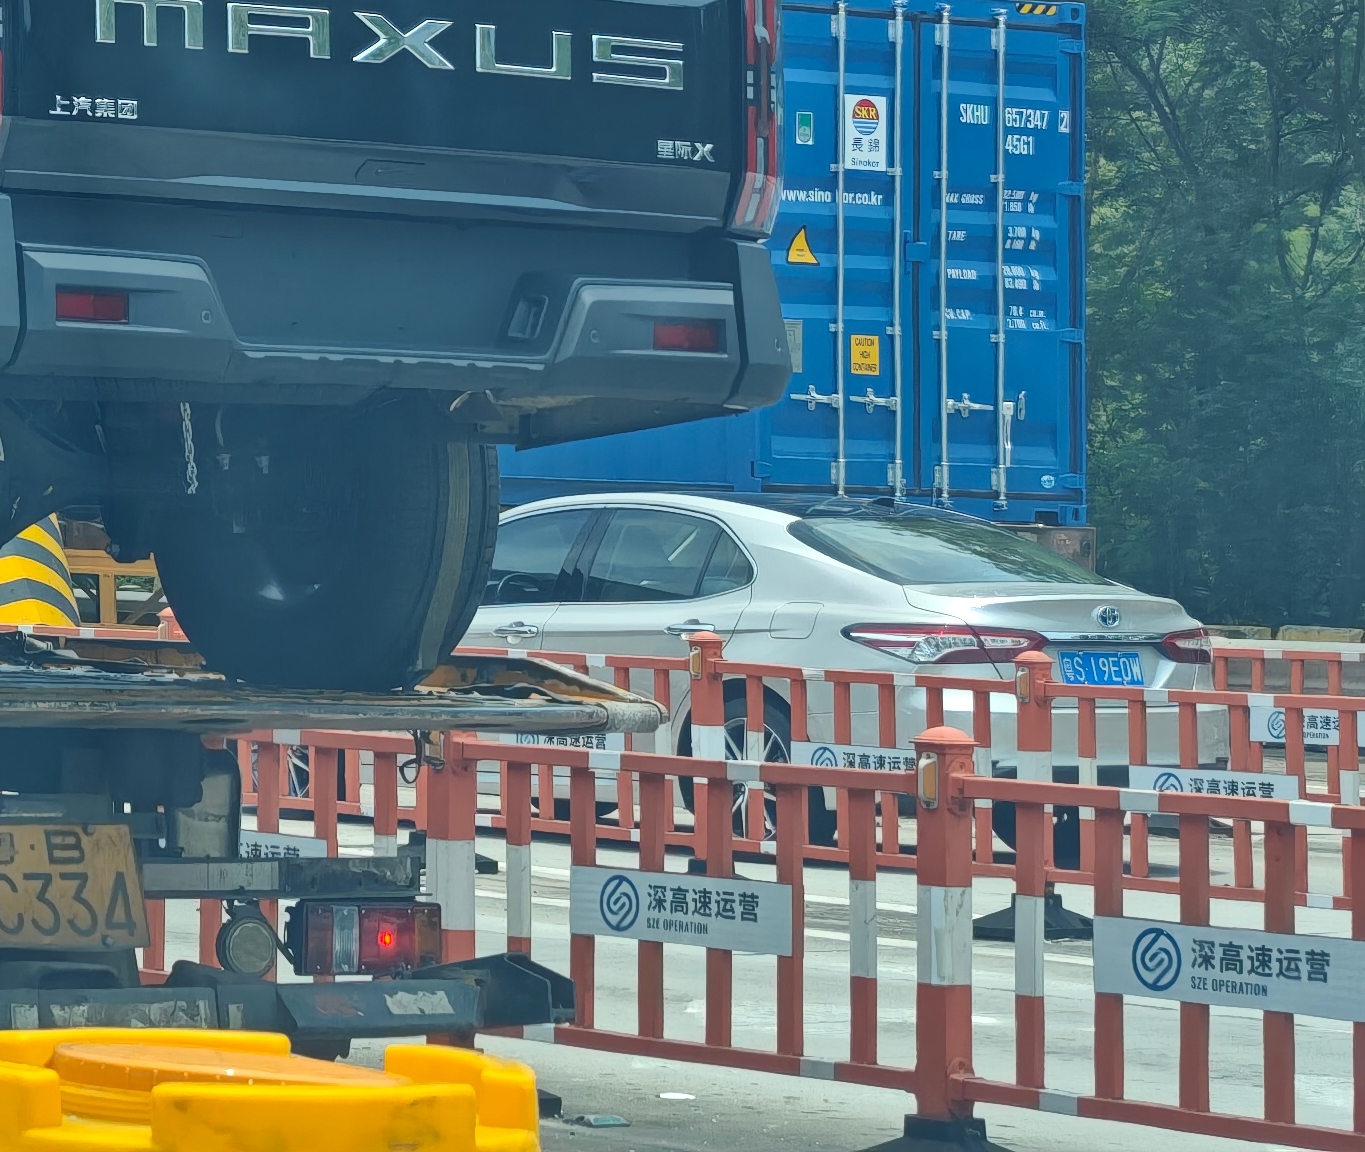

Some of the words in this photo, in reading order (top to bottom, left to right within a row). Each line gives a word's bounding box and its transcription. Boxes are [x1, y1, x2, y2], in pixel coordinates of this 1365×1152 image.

[49, 95, 138, 119] 上汽集团
[854, 106, 877, 120] SKR
[960, 103, 988, 124] SKHU
[1005, 108, 1048, 129] 657347
[657, 140, 715, 162] 星际X
[1005, 135, 1033, 155] 45G1
[780, 188, 883, 206] www.sinoor.co.kr
[647, 884, 759, 923] 深高速运营
[663, 919, 709, 935] OPERATION
[1190, 938, 1331, 984] 深高速运营
[1190, 976, 1208, 991] SZE
[1212, 979, 1268, 997] OPERATION
